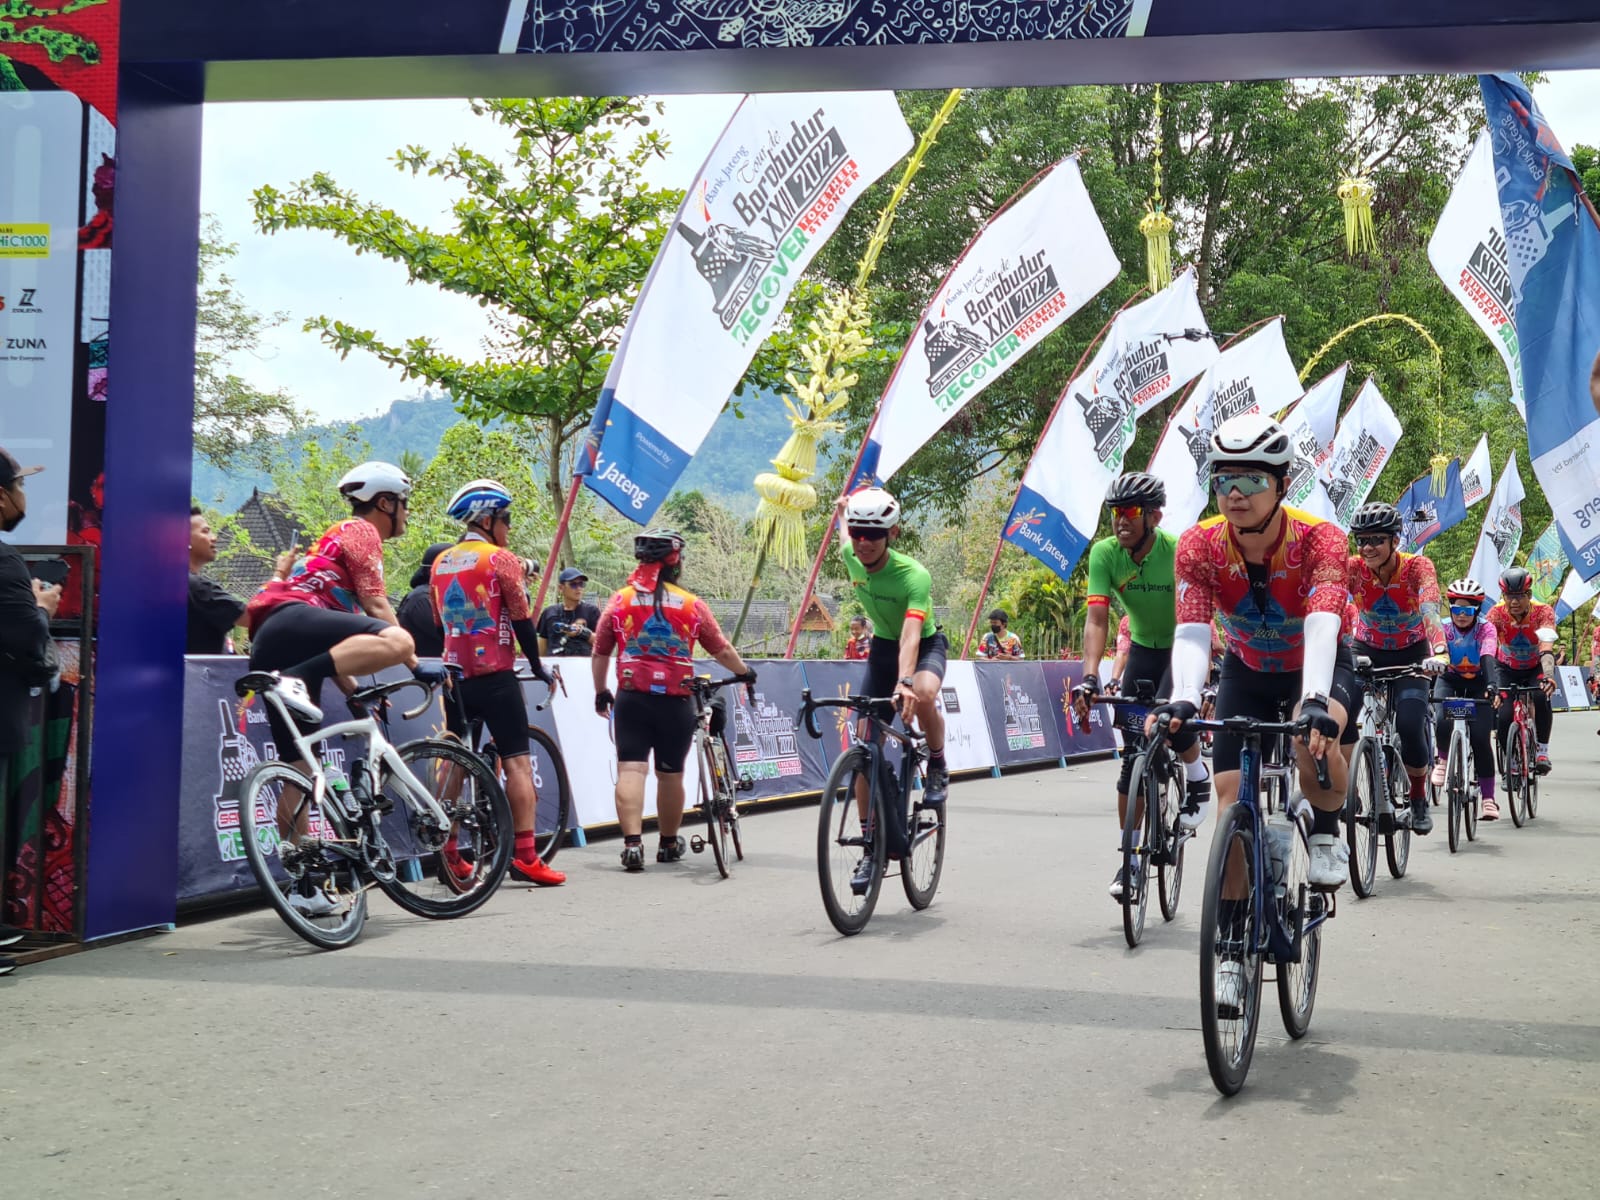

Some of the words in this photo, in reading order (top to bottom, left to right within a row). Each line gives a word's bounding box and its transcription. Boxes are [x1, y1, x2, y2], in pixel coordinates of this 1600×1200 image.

[705, 175, 727, 205] Bank
[723, 143, 750, 184] Jateng
[732, 107, 825, 227] Borobudur
[761, 184, 797, 243] XXII
[792, 131, 840, 197] 2022
[799, 159, 858, 231] TOGETHER
[808, 170, 859, 235] STRONGER
[10, 236, 47, 247] C1000
[731, 228, 810, 341] RECOVER
[964, 249, 1046, 326] Borobudur
[983, 301, 1016, 342] XXII
[1014, 270, 1053, 315] 2022
[1013, 291, 1066, 338] TOGETHER
[1020, 300, 1068, 341] STRONGER
[7, 339, 47, 349] ZUNA
[1135, 358, 1164, 383] 2022
[935, 334, 1022, 412] RECOVER
[1225, 391, 1252, 417] 2022
[597, 461, 650, 510] Jateng
[1019, 522, 1044, 545] Bank
[1039, 538, 1069, 571] Jateng
[247, 709, 268, 724] Bank
